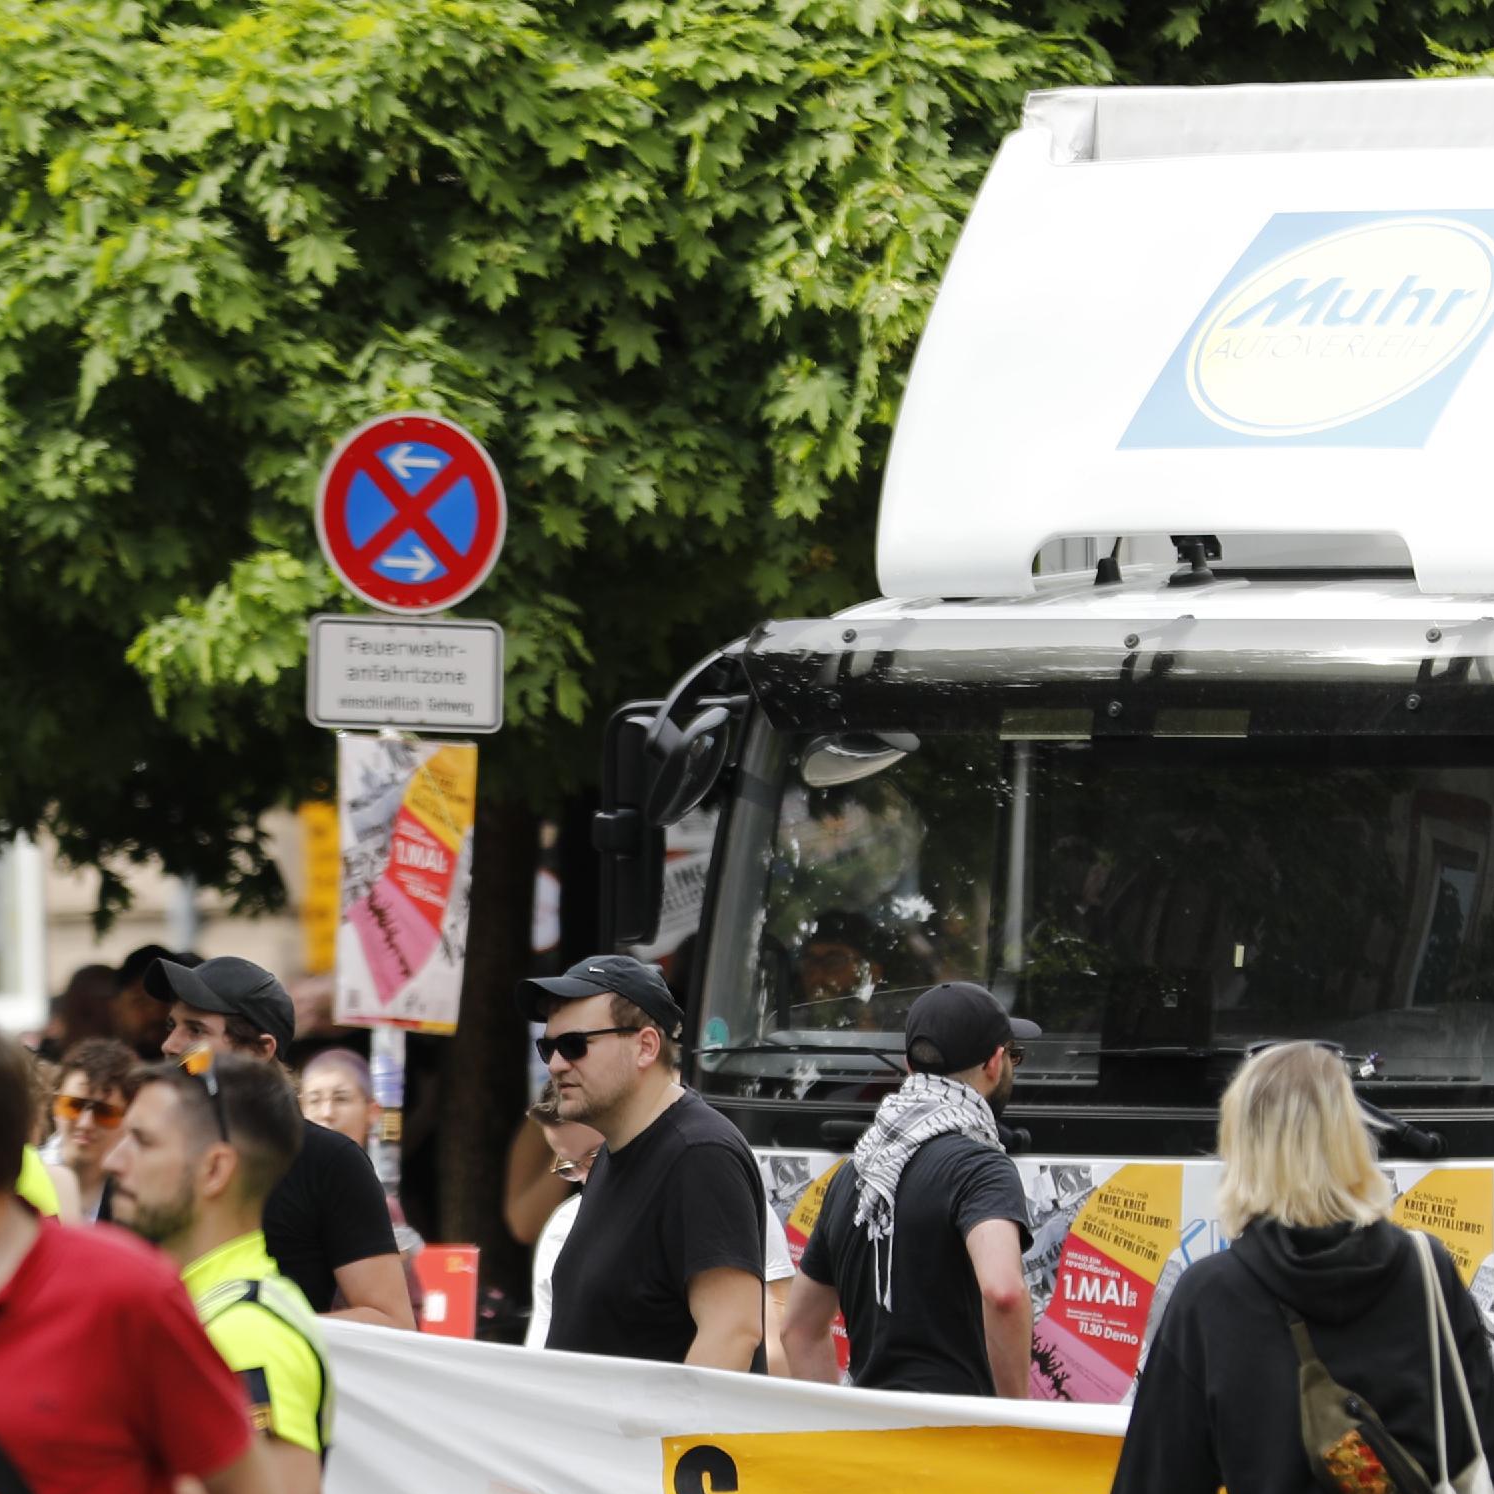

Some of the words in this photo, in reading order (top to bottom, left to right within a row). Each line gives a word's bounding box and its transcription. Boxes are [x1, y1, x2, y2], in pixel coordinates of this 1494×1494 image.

[1221, 274, 1480, 331] Muhr
[1207, 334, 1435, 361] AUTOVERLEIH
[346, 636, 468, 659] Feuerwehr-
[346, 664, 468, 686] anfahrtzone
[427, 697, 475, 717] Gehweg
[1123, 1198, 1147, 1212] KRIEG
[1413, 1191, 1444, 1203] Schluss
[1444, 1196, 1459, 1206] mit
[1114, 1208, 1173, 1230] KAPITALISMUS!
[1431, 1204, 1456, 1218] KRIEG
[1403, 1211, 1420, 1221] UND
[1421, 1215, 1485, 1235] KAPITALISMUS!
[1082, 1220, 1112, 1242] SOZIALE
[1113, 1234, 1161, 1261] REVOLUTION!
[1063, 1275, 1129, 1307] 1.MAI
[1079, 1320, 1102, 1338] 11.30
[1103, 1327, 1139, 1346] Demo
